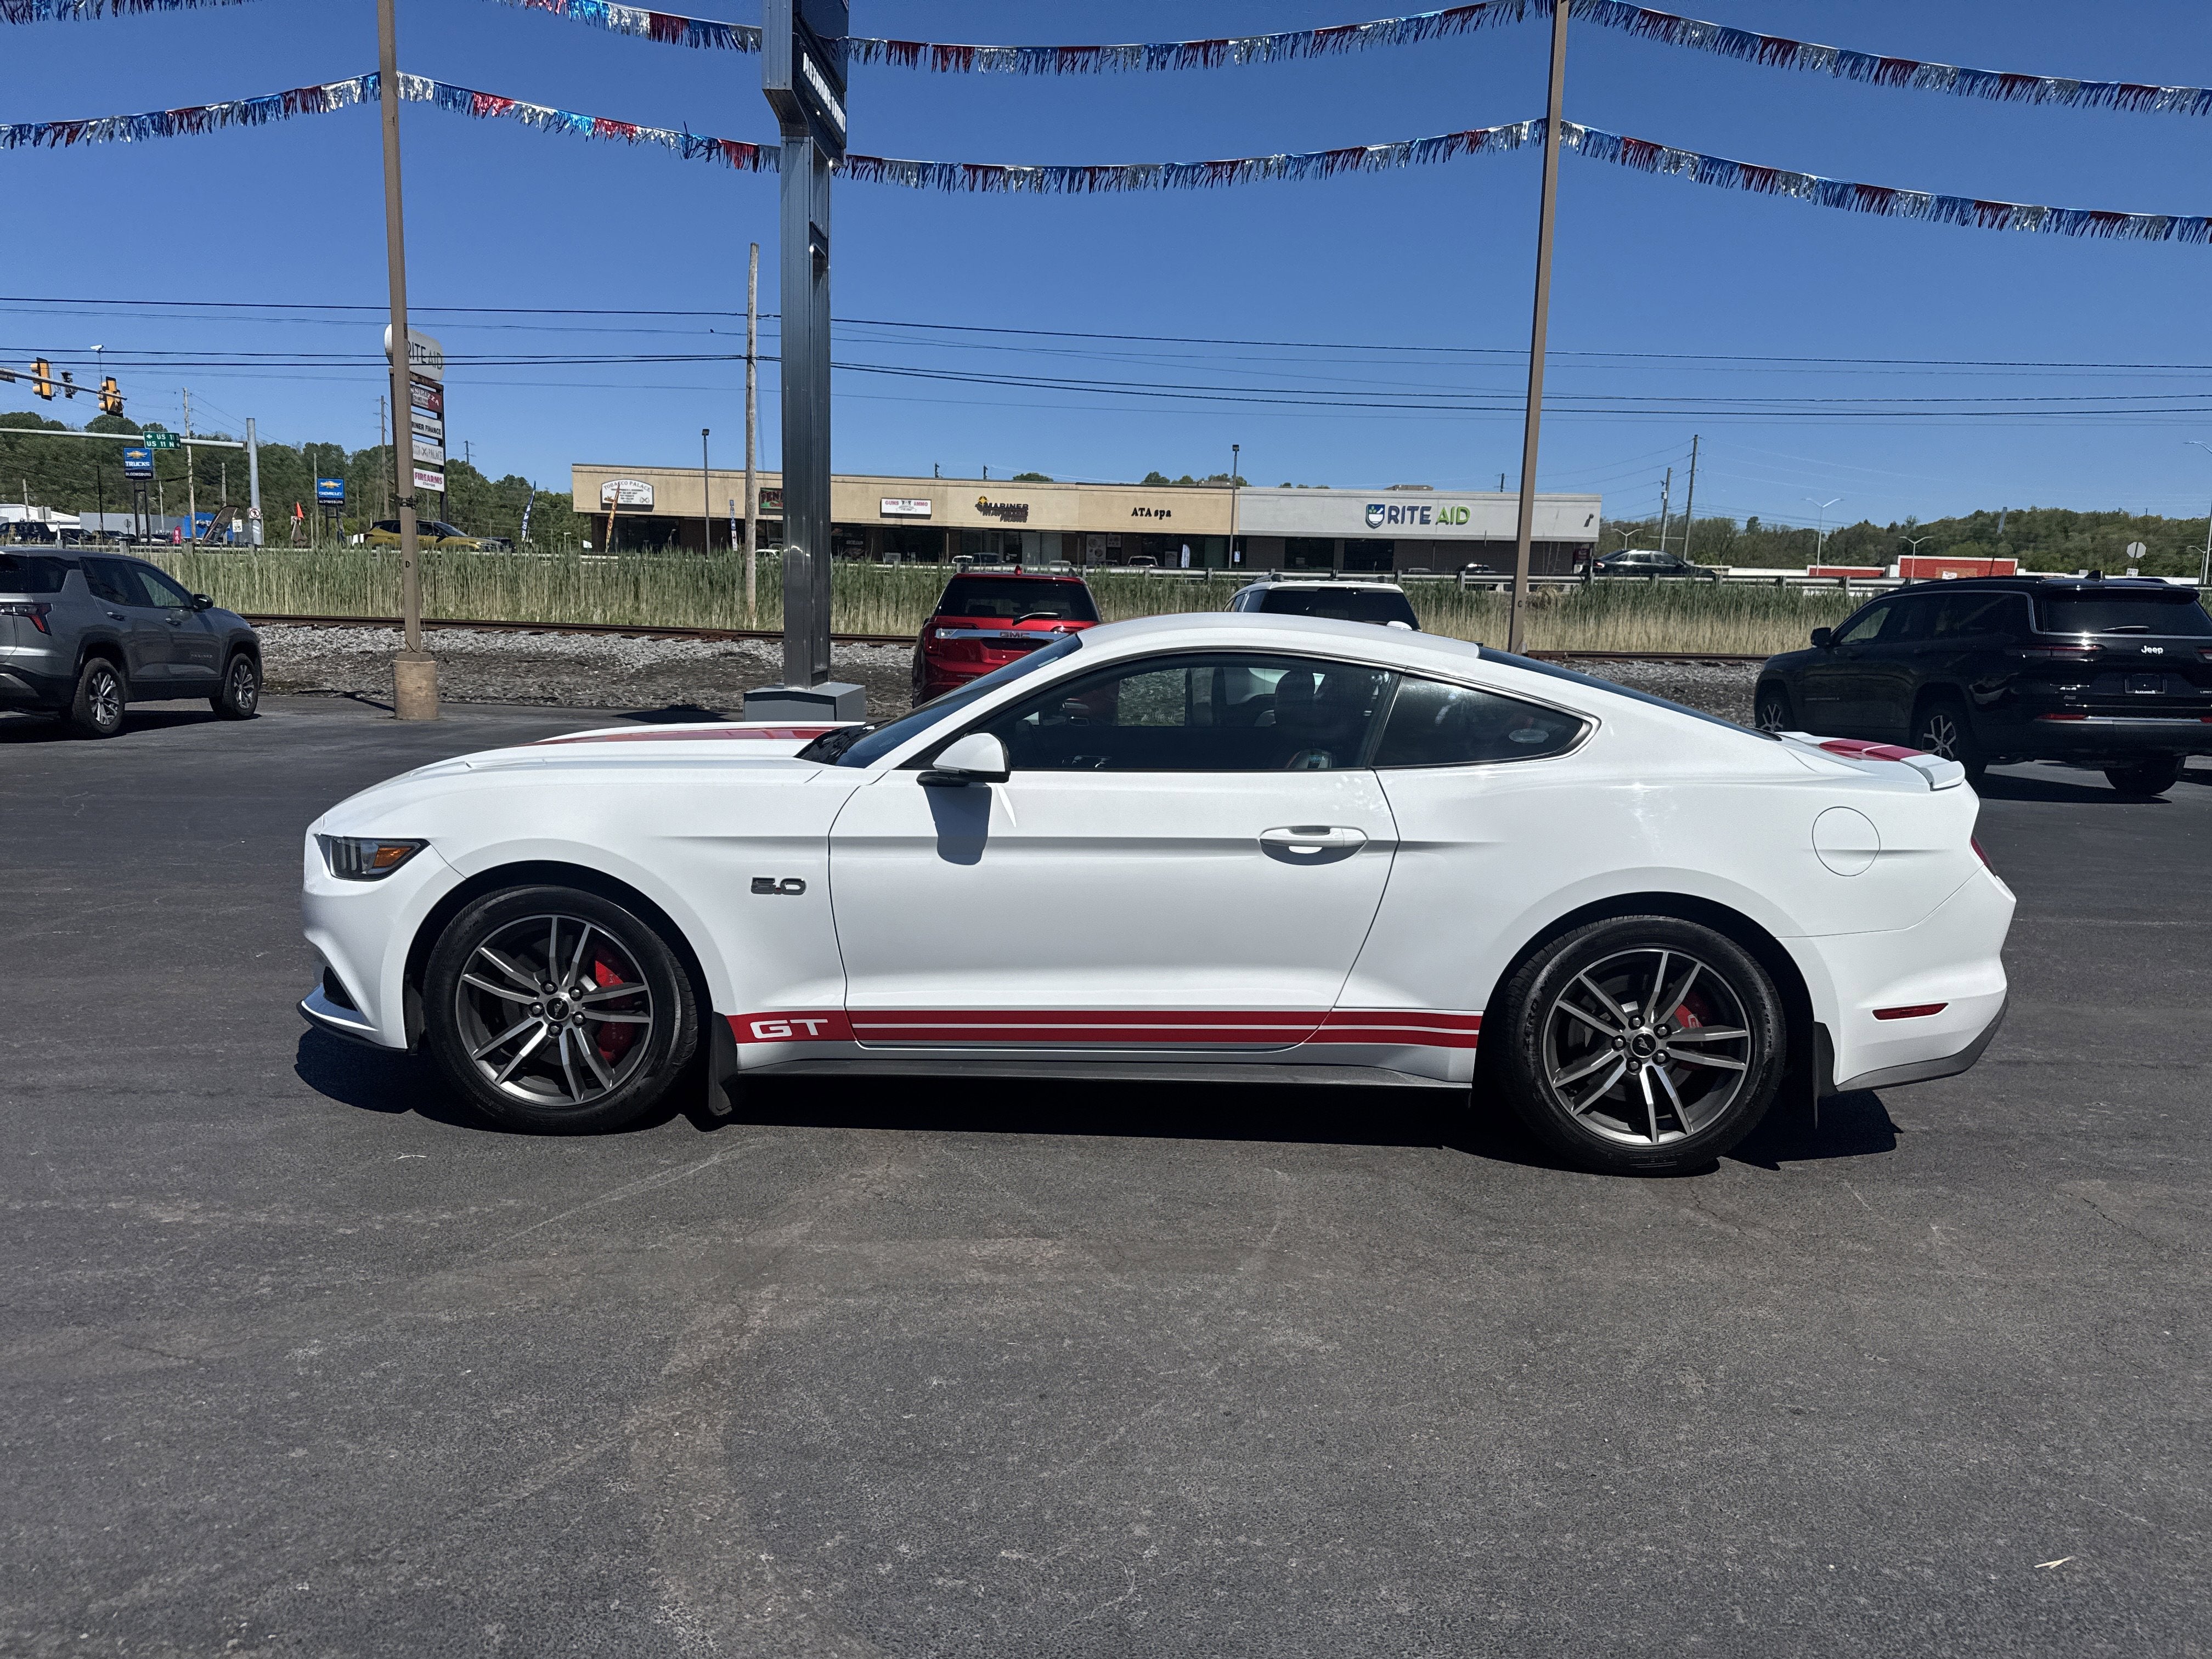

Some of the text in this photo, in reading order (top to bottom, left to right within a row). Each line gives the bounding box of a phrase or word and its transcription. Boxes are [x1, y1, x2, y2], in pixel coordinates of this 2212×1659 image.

[428, 350, 443, 370] AID
[425, 425, 442, 435] FINANCE
[415, 472, 443, 485] FIREARMS
[629, 481, 651, 493] PALACE
[1131, 507, 1171, 520] ATA spa
[1387, 505, 1470, 525] RITE AID
[2141, 645, 2164, 654] Jeep
[751, 877, 807, 896] 5.0
[749, 1019, 828, 1039] GT
